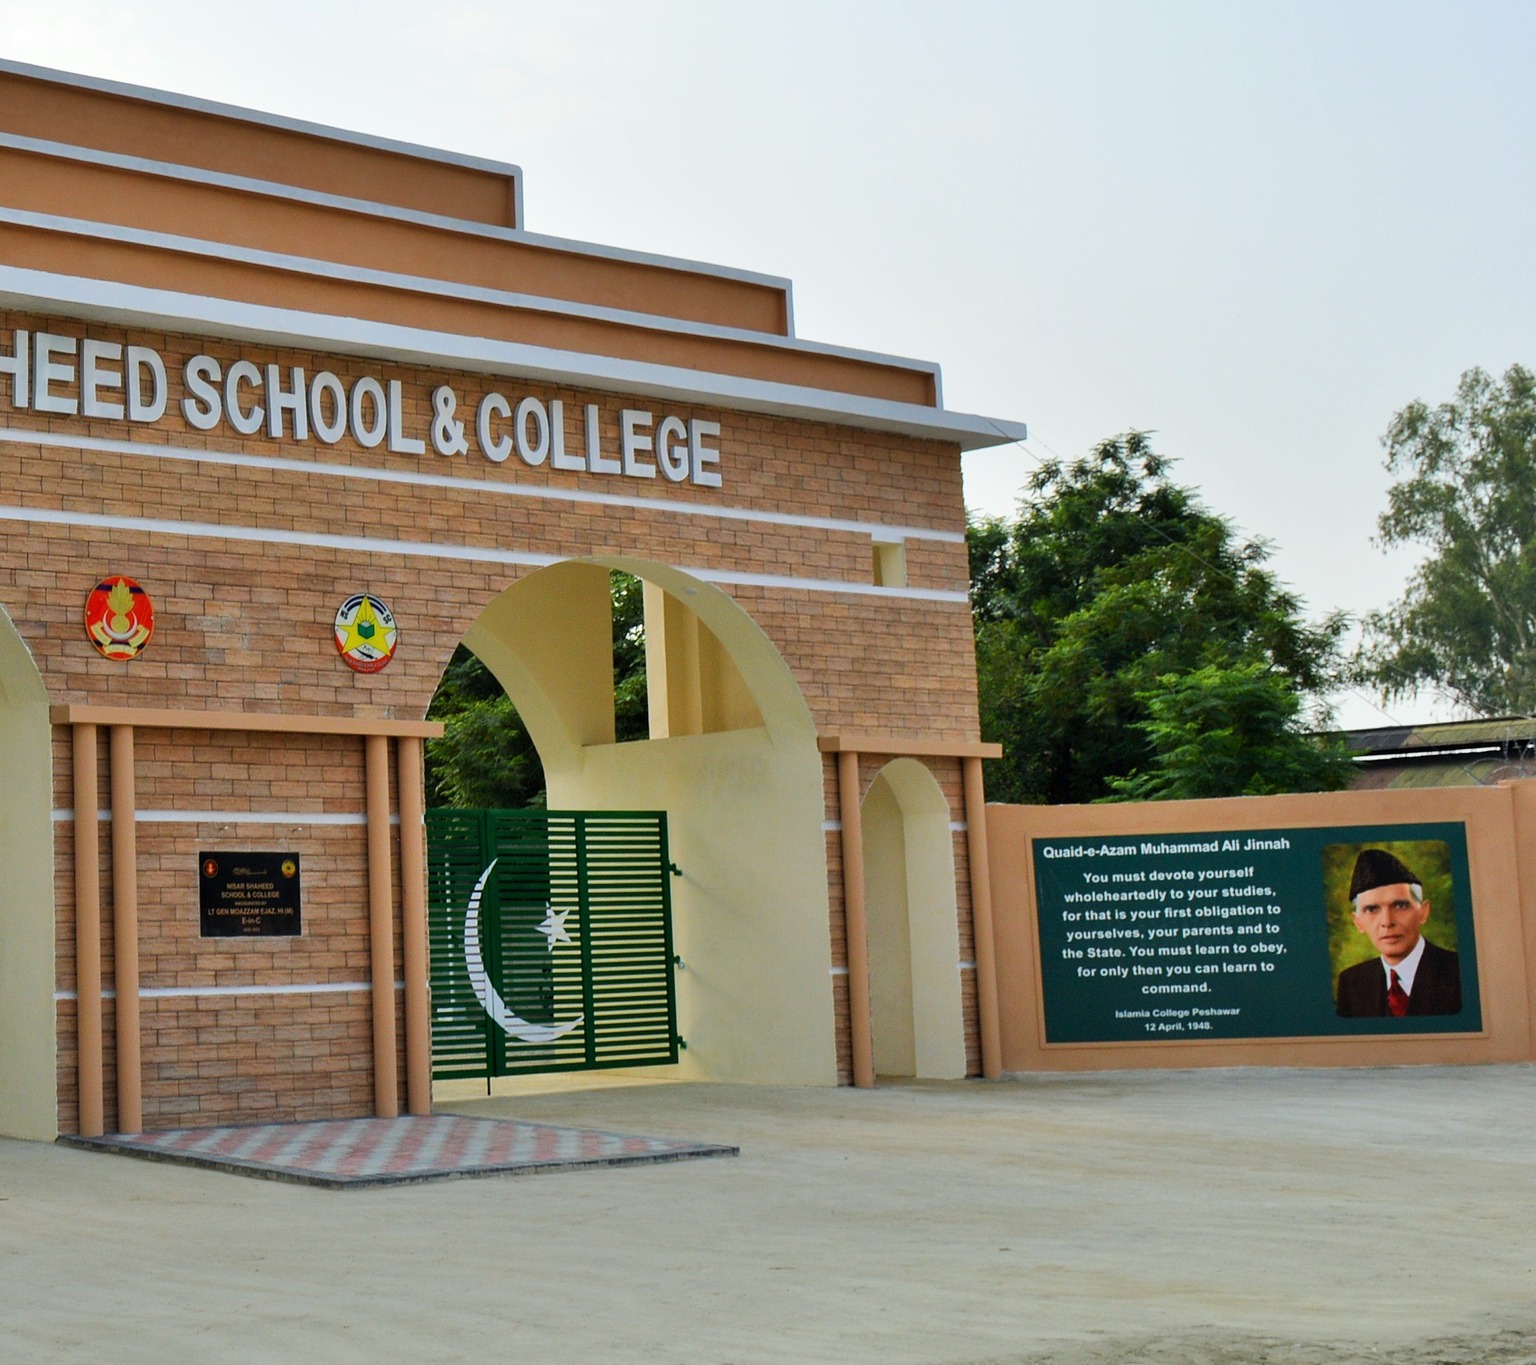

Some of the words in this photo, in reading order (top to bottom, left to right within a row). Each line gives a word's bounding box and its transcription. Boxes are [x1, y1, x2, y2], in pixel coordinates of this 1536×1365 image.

[181, 354, 426, 455] SCHOOL
[431, 385, 469, 456] &
[476, 391, 723, 488] COLLEGE
[1043, 845, 1137, 858] Quaid-e-Azam
[1141, 840, 1219, 854] Muhammad
[1222, 839, 1240, 851] Ali
[1244, 838, 1290, 850] Jinnah
[1083, 873, 1108, 883] You
[1112, 872, 1145, 882] must
[1149, 870, 1194, 881] devote
[1198, 867, 1253, 881] yourself
[1064, 889, 1166, 902] wholeheartedly
[1170, 889, 1184, 899] to
[1187, 889, 1218, 901] your
[1222, 886, 1276, 897] studies,
[1063, 911, 1081, 921] for
[1085, 910, 1111, 920] that
[1115, 909, 1126, 919] is
[1130, 910, 1161, 921] your
[1164, 907, 1191, 918] first
[1195, 905, 1263, 918] obligation
[1267, 905, 1281, 914] to
[1067, 928, 1144, 942] yourselves,
[1148, 929, 1178, 939] your
[1182, 925, 1233, 938] parents
[1237, 923, 1262, 934] and
[1266, 924, 1280, 933] to
[1062, 949, 1083, 958] the
[1087, 948, 1125, 958] State.
[1129, 946, 1154, 956] You
[1158, 946, 1192, 955] must
[1196, 944, 1229, 954] learn
[1233, 944, 1247, 953] to
[1251, 942, 1287, 954] obey,
[1077, 967, 1096, 977] for
[1100, 966, 1128, 978] only
[1133, 965, 1162, 975] then
[1166, 966, 1191, 977] you
[1195, 965, 1219, 973] can
[1223, 962, 1257, 972] learn
[1261, 962, 1274, 971] to
[1142, 982, 1211, 994] command.
[1116, 1010, 1150, 1018] Islamia
[1153, 1009, 1189, 1018] College
[1192, 1008, 1240, 1016] Peshawar
[1145, 1023, 1156, 1031] 12
[1158, 1023, 1184, 1032] April,
[1188, 1022, 1212, 1030] 1948.
